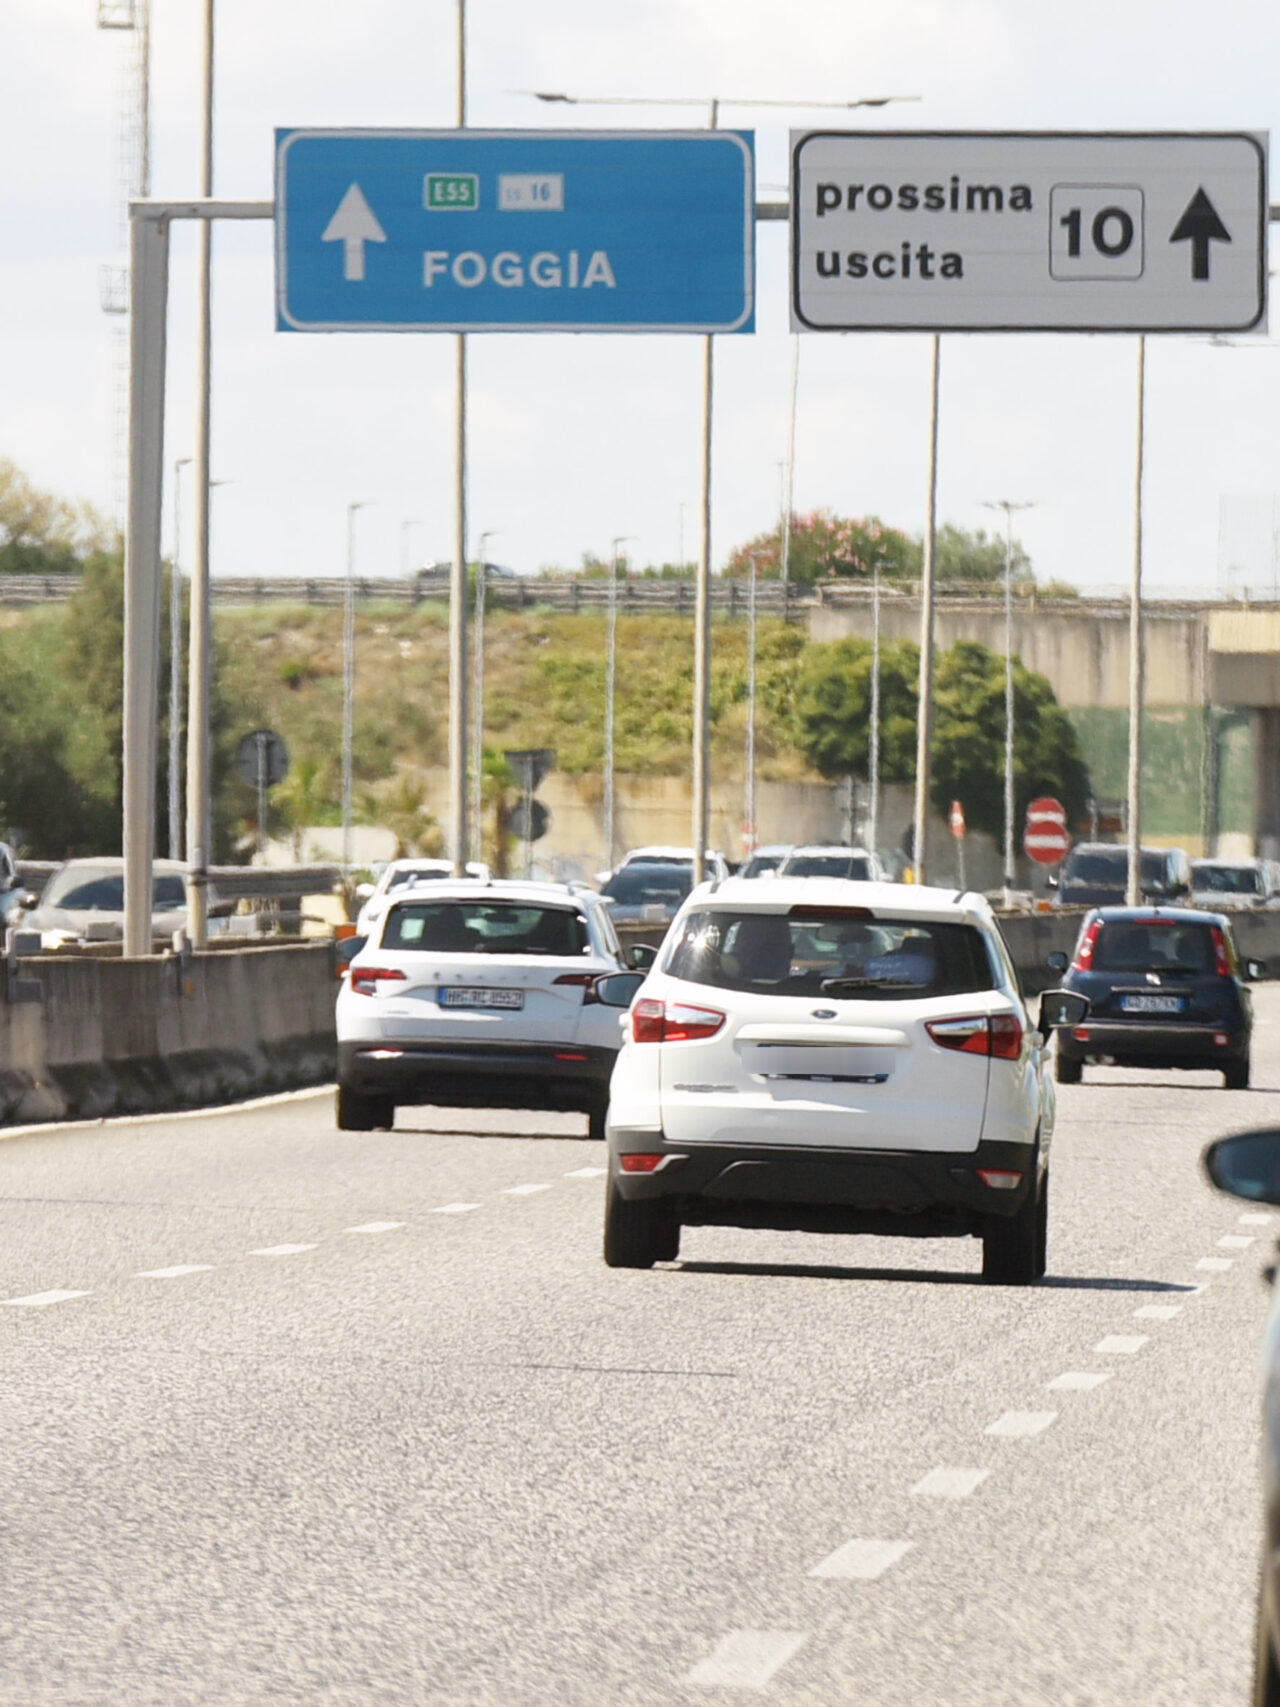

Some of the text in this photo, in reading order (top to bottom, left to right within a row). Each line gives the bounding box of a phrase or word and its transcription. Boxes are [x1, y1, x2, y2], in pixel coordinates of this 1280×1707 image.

[532, 181, 551, 201] 16
[815, 175, 1034, 216] prossima
[1060, 206, 1136, 259] 10
[423, 250, 617, 289] FOGGIA
[815, 241, 965, 279] uscita
